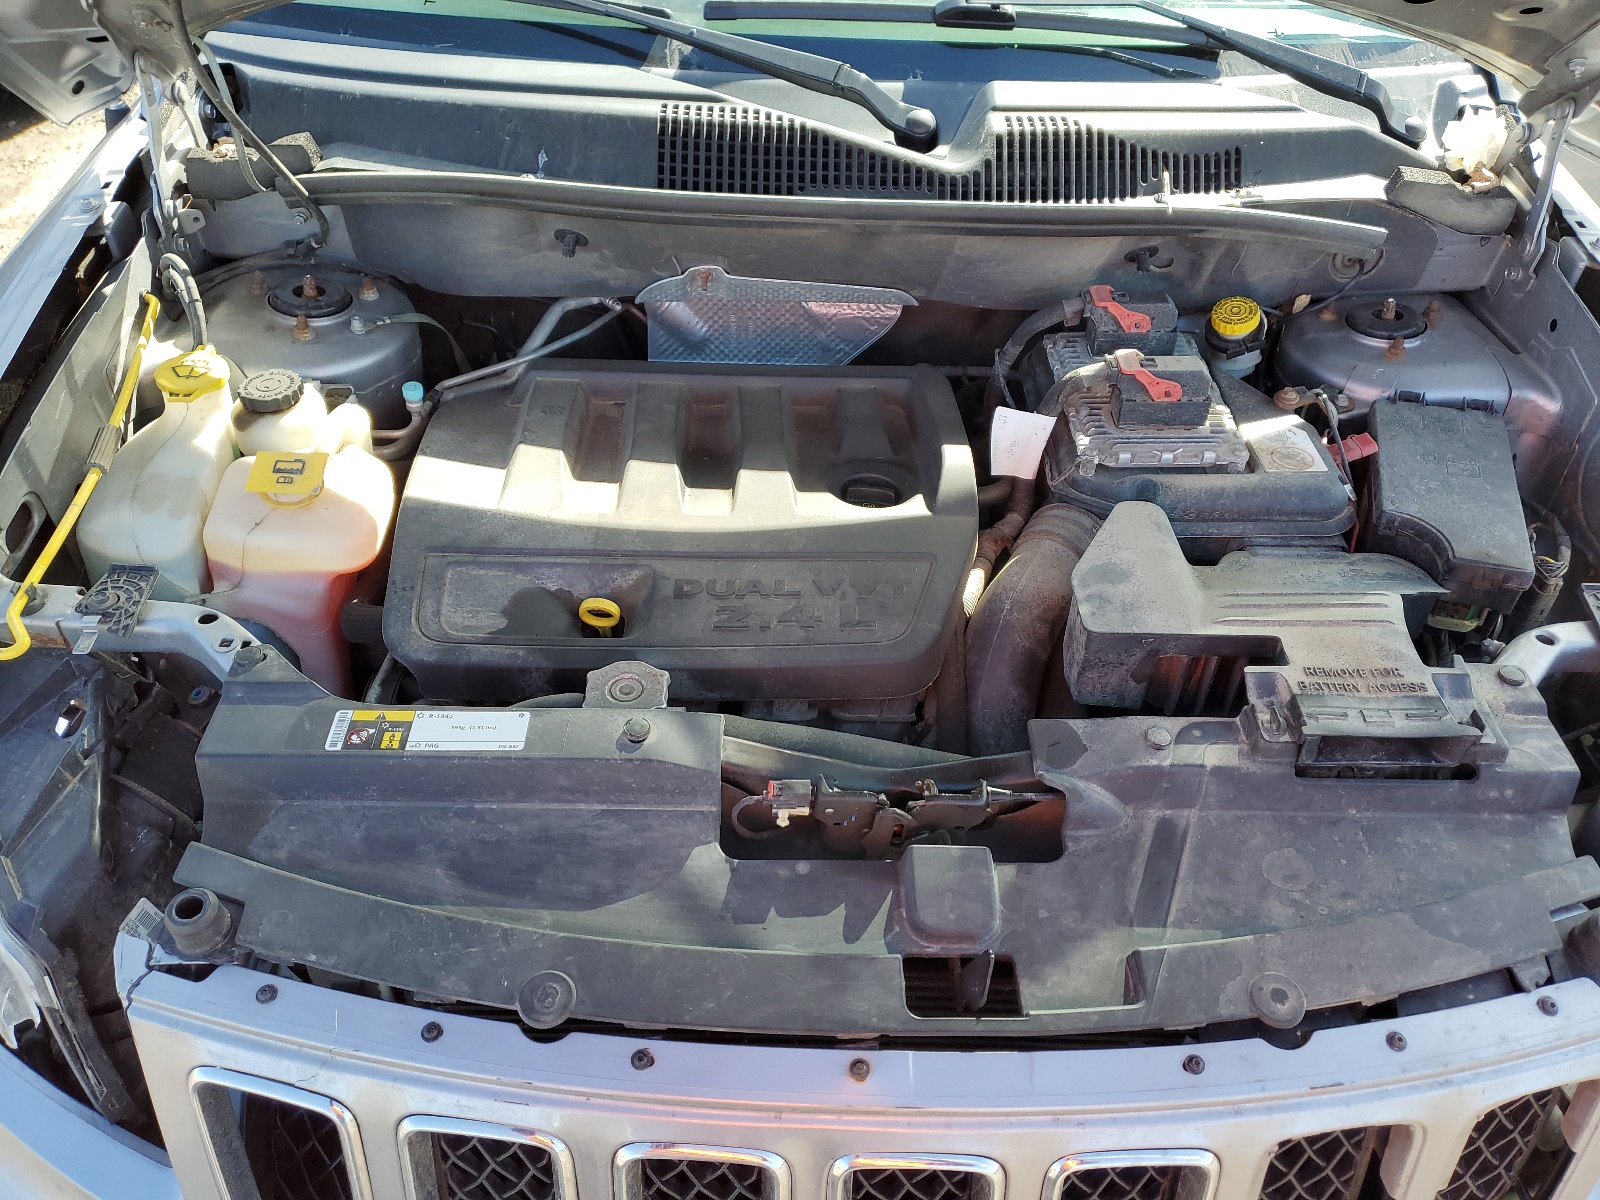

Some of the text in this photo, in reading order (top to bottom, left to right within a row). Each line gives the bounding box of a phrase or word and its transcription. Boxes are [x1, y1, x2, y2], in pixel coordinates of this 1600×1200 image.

[673, 577, 914, 599] DUAL VVT
[712, 603, 877, 632] 2.4L
[1302, 666, 1405, 678] REMOVE FOR
[1297, 680, 1430, 693] BATTERY ACCESS
